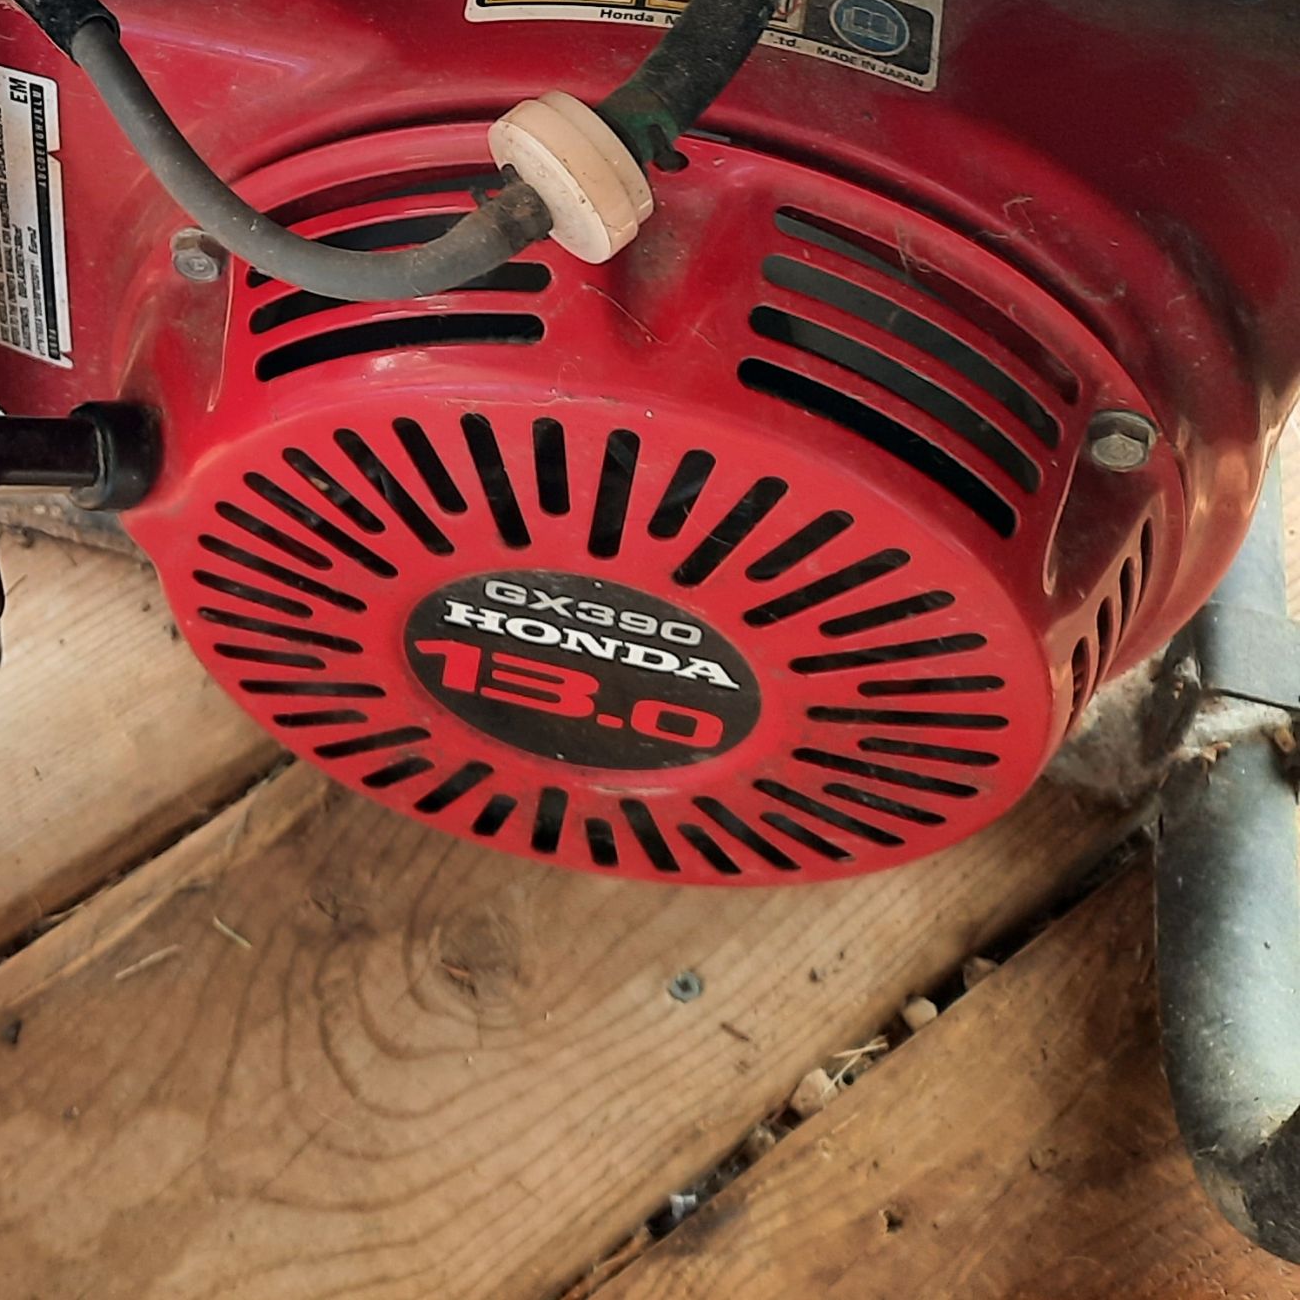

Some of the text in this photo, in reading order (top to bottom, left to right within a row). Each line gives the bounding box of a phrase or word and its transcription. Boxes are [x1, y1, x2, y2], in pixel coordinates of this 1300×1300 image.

[600, 9, 654, 22] Honda
[817, 46, 856, 65] MADE
[861, 60, 876, 72] IN
[879, 62, 923, 87] JAPAN
[9, 77, 28, 104] EM
[444, 600, 740, 690] HONDA
[484, 580, 704, 647] GX390
[414, 639, 724, 748] 13.0
